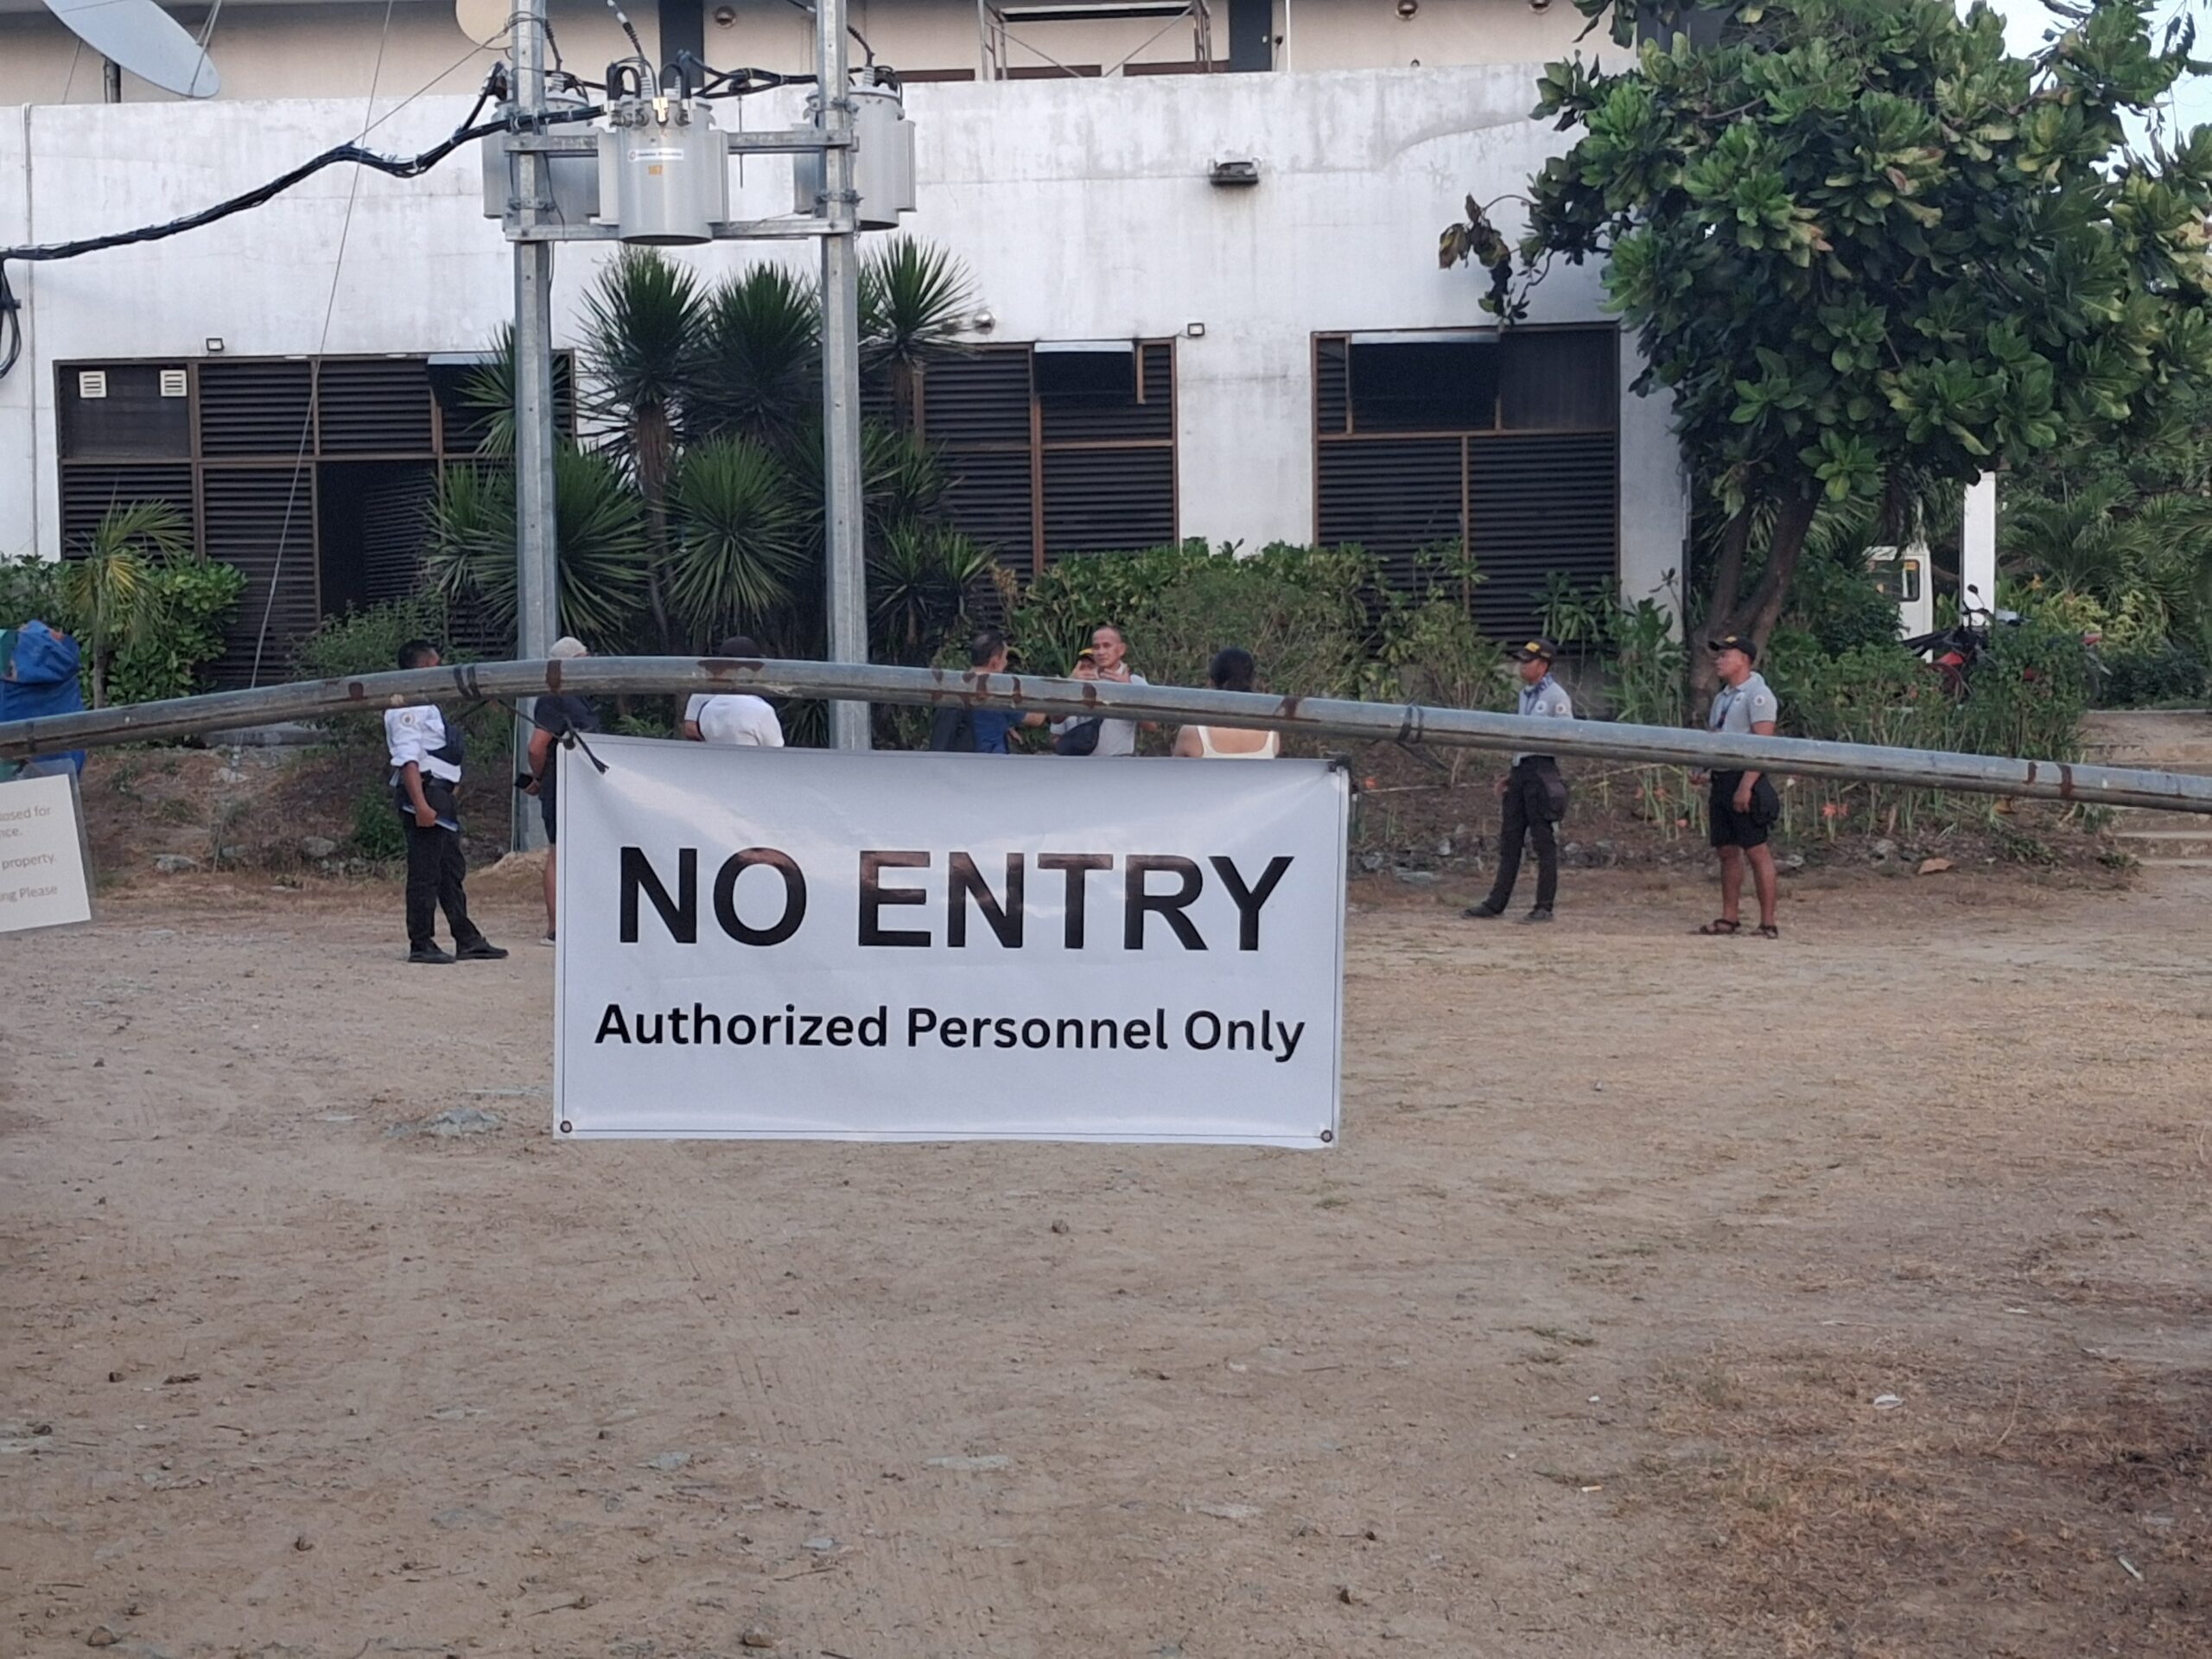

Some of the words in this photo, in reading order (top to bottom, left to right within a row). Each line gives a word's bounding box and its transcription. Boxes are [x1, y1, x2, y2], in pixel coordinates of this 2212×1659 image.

[0, 806, 31, 822] osed
[35, 804, 52, 817] for
[19, 886, 58, 899] Please
[620, 847, 806, 946] NO
[858, 850, 1294, 951] ENTRY
[594, 1003, 887, 1046] Authorized
[908, 1007, 1168, 1050] Personnel
[1185, 1009, 1306, 1063] Only
